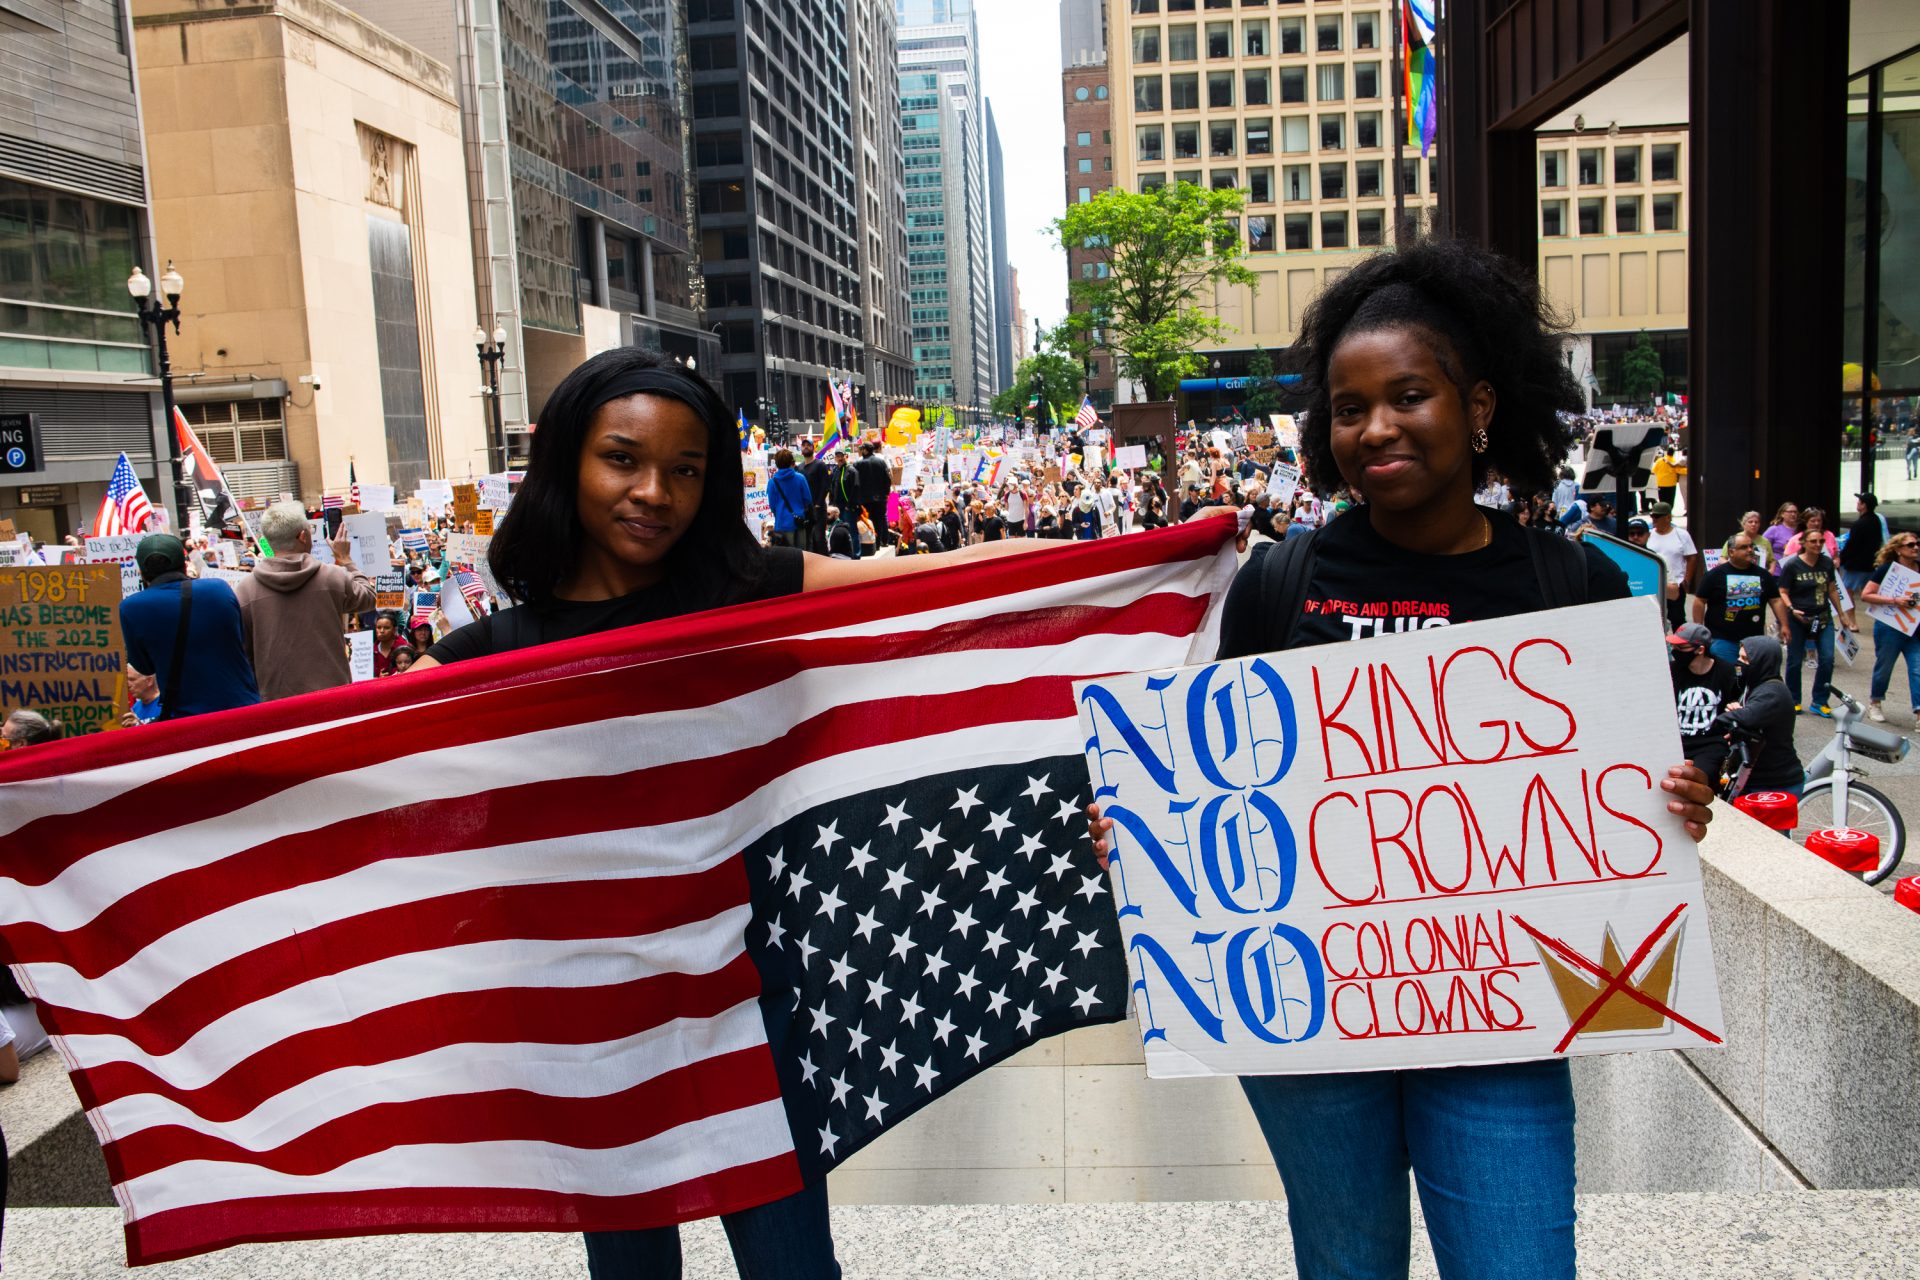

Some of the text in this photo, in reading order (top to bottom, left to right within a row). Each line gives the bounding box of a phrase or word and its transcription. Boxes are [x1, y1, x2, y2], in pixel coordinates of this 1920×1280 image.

[377, 584, 404, 592] Regime
[378, 577, 403, 585] Fascist
[1304, 600, 1320, 613] OF
[1360, 602, 1389, 617] AND
[1392, 601, 1450, 617] DREAMS
[1883, 576, 1910, 616] PARIOTS
[38, 603, 113, 626] BECOME
[12, 628, 110, 648] THE 2025
[1, 678, 112, 707] MANUAL
[1082, 638, 1577, 799] NO KINGS
[1103, 764, 1663, 919] NO CROWNS
[1129, 910, 1511, 1045] NO COLONIAL
[1331, 970, 1524, 1041] CLOWNS
